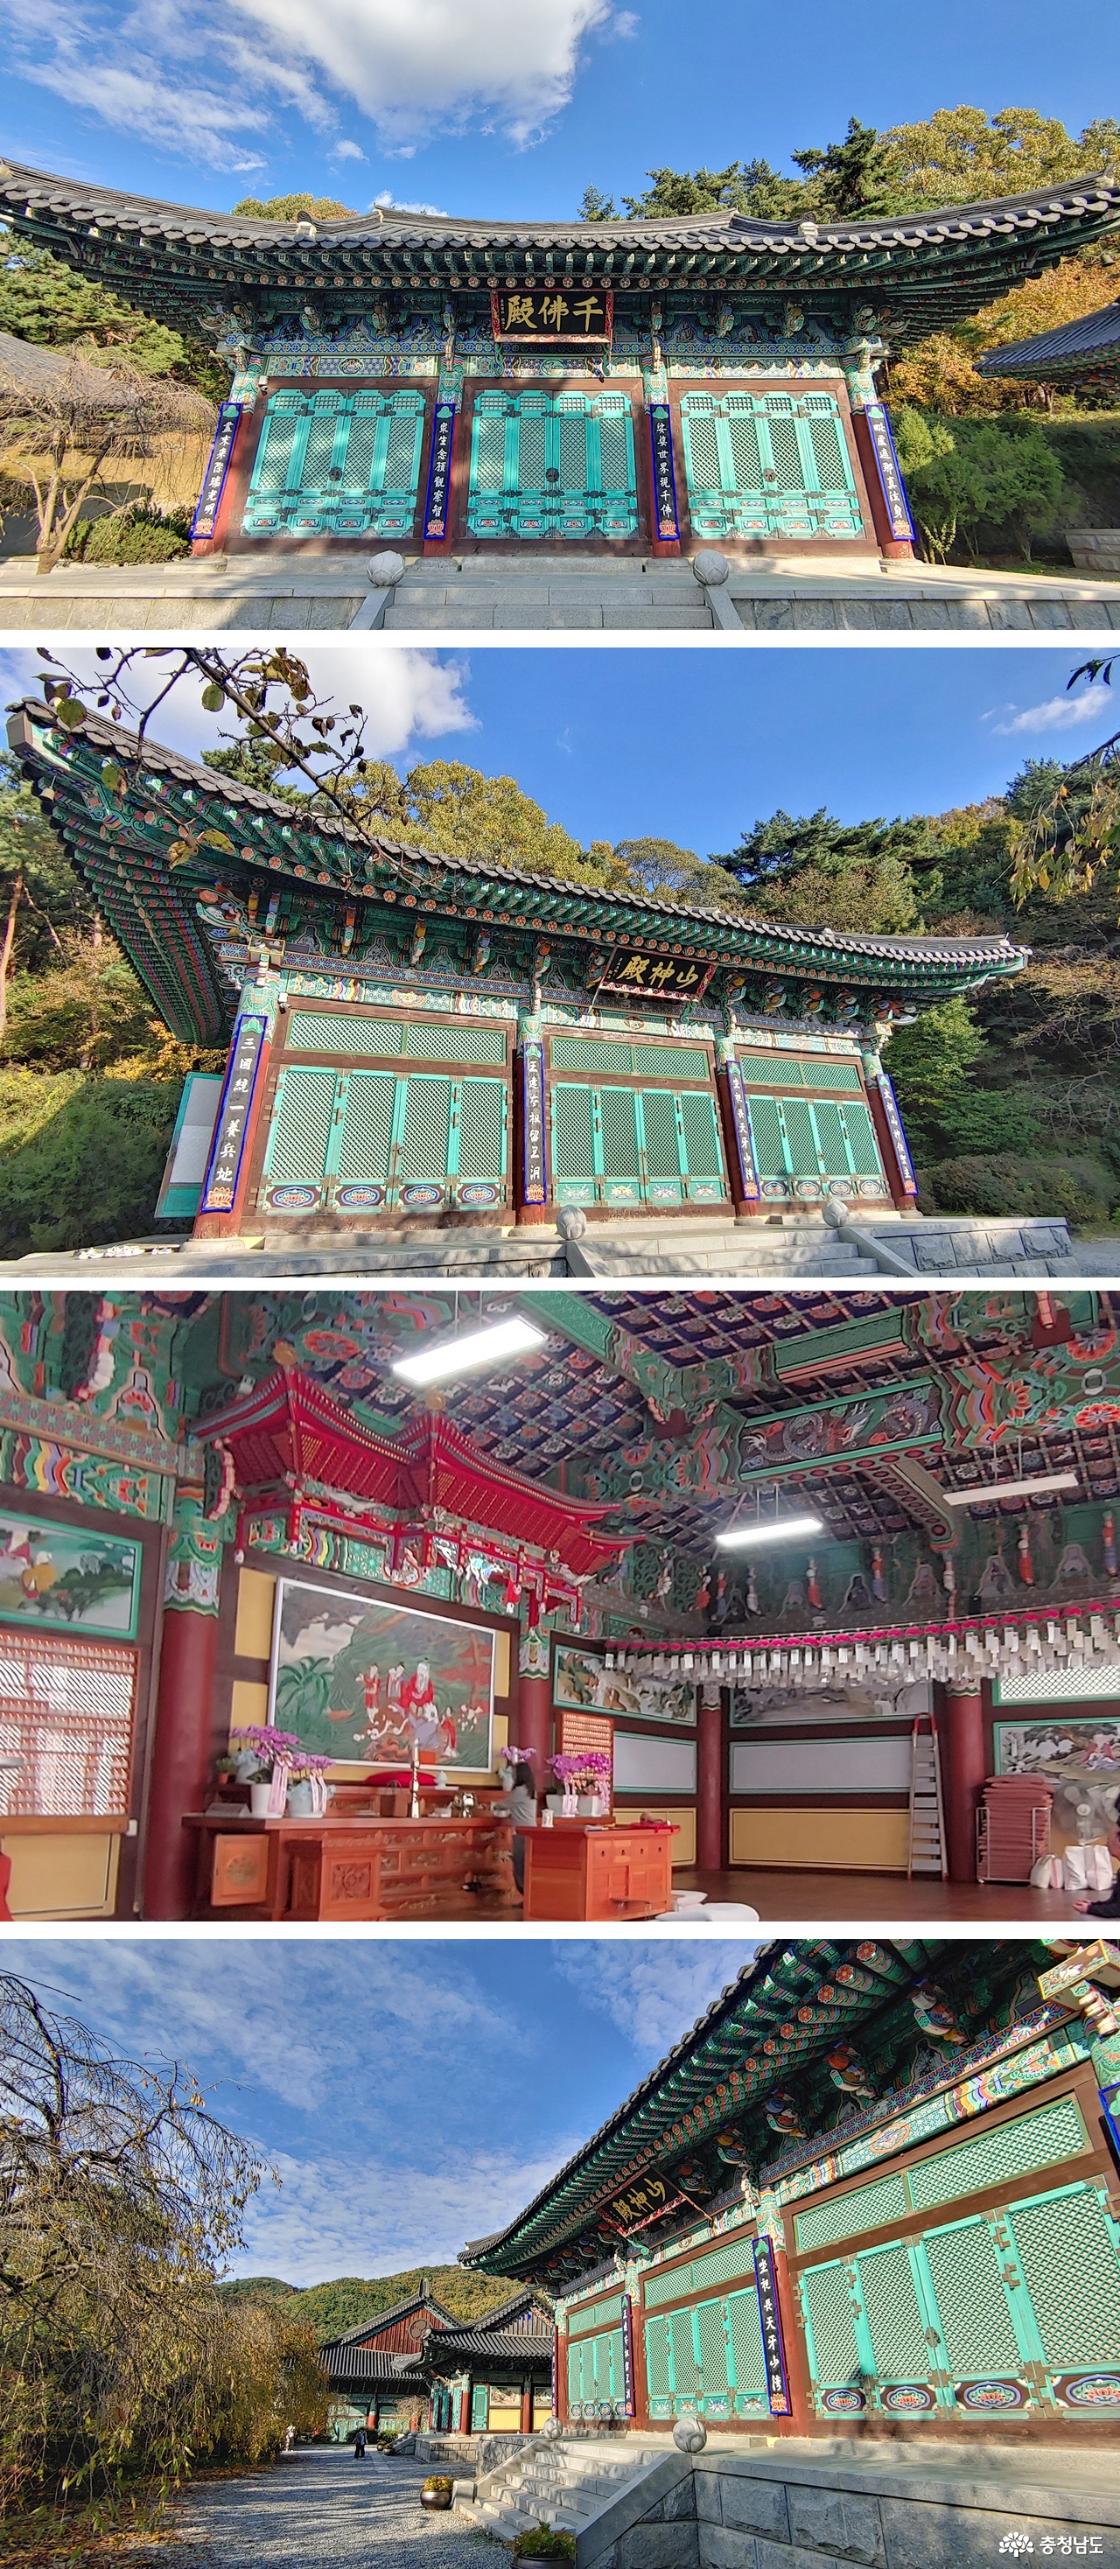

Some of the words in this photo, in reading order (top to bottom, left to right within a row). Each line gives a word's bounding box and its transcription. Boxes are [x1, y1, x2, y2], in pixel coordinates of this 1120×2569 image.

[504, 295, 604, 332] 千佛殿
[616, 955, 699, 989] 山神殿
[612, 2178, 666, 2224] 山神殿
